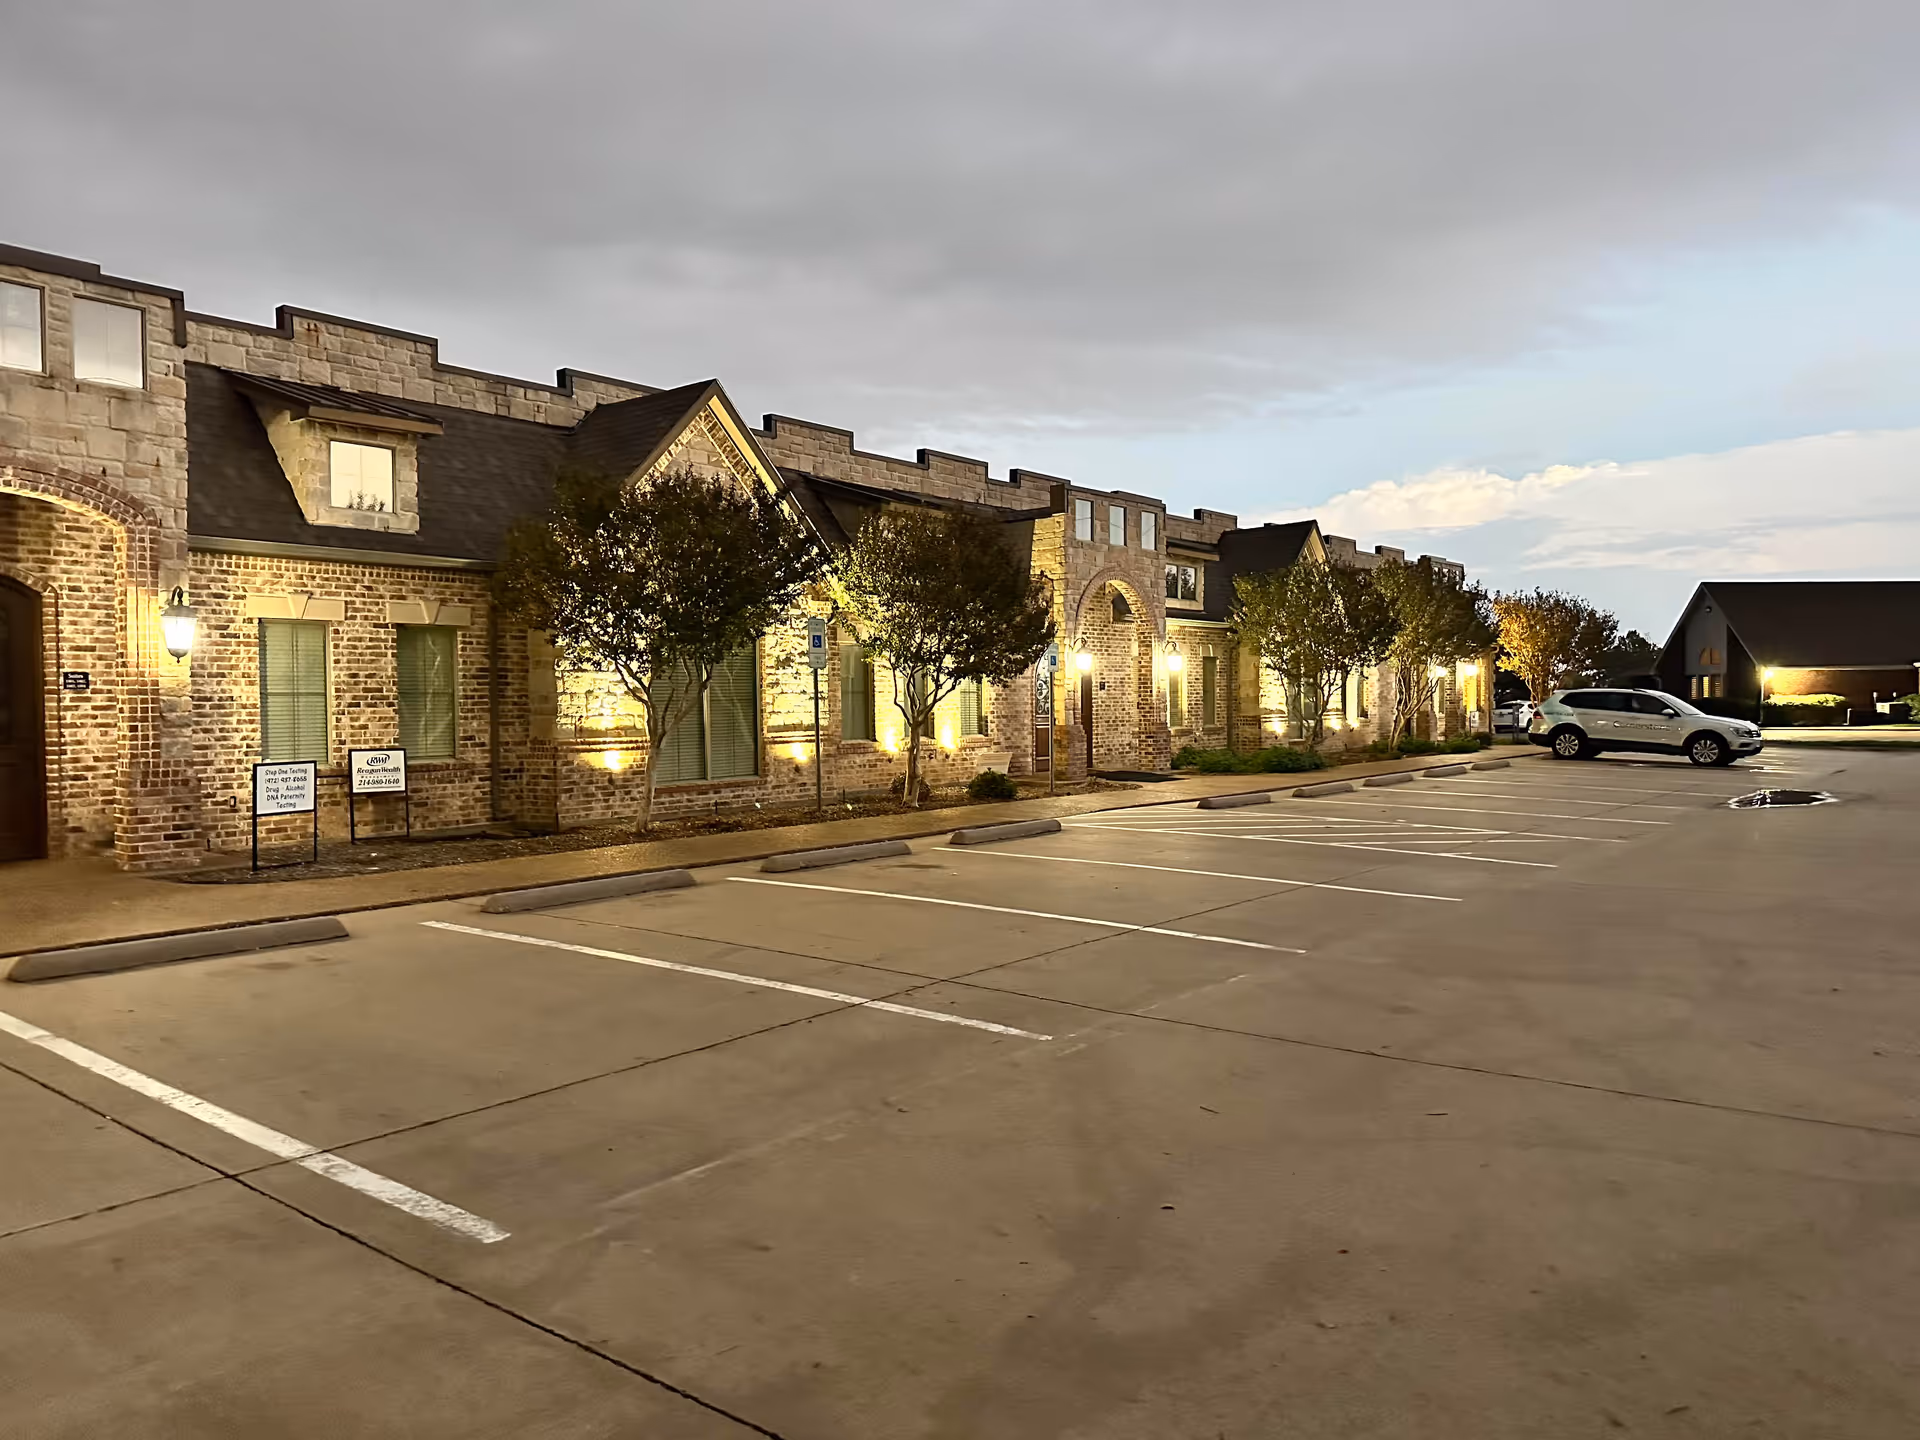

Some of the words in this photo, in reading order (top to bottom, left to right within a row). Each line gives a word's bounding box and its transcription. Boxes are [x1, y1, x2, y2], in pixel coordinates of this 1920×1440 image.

[289, 767, 308, 775] Testing
[356, 767, 380, 775] Reagan
[276, 801, 297, 809] Testing
